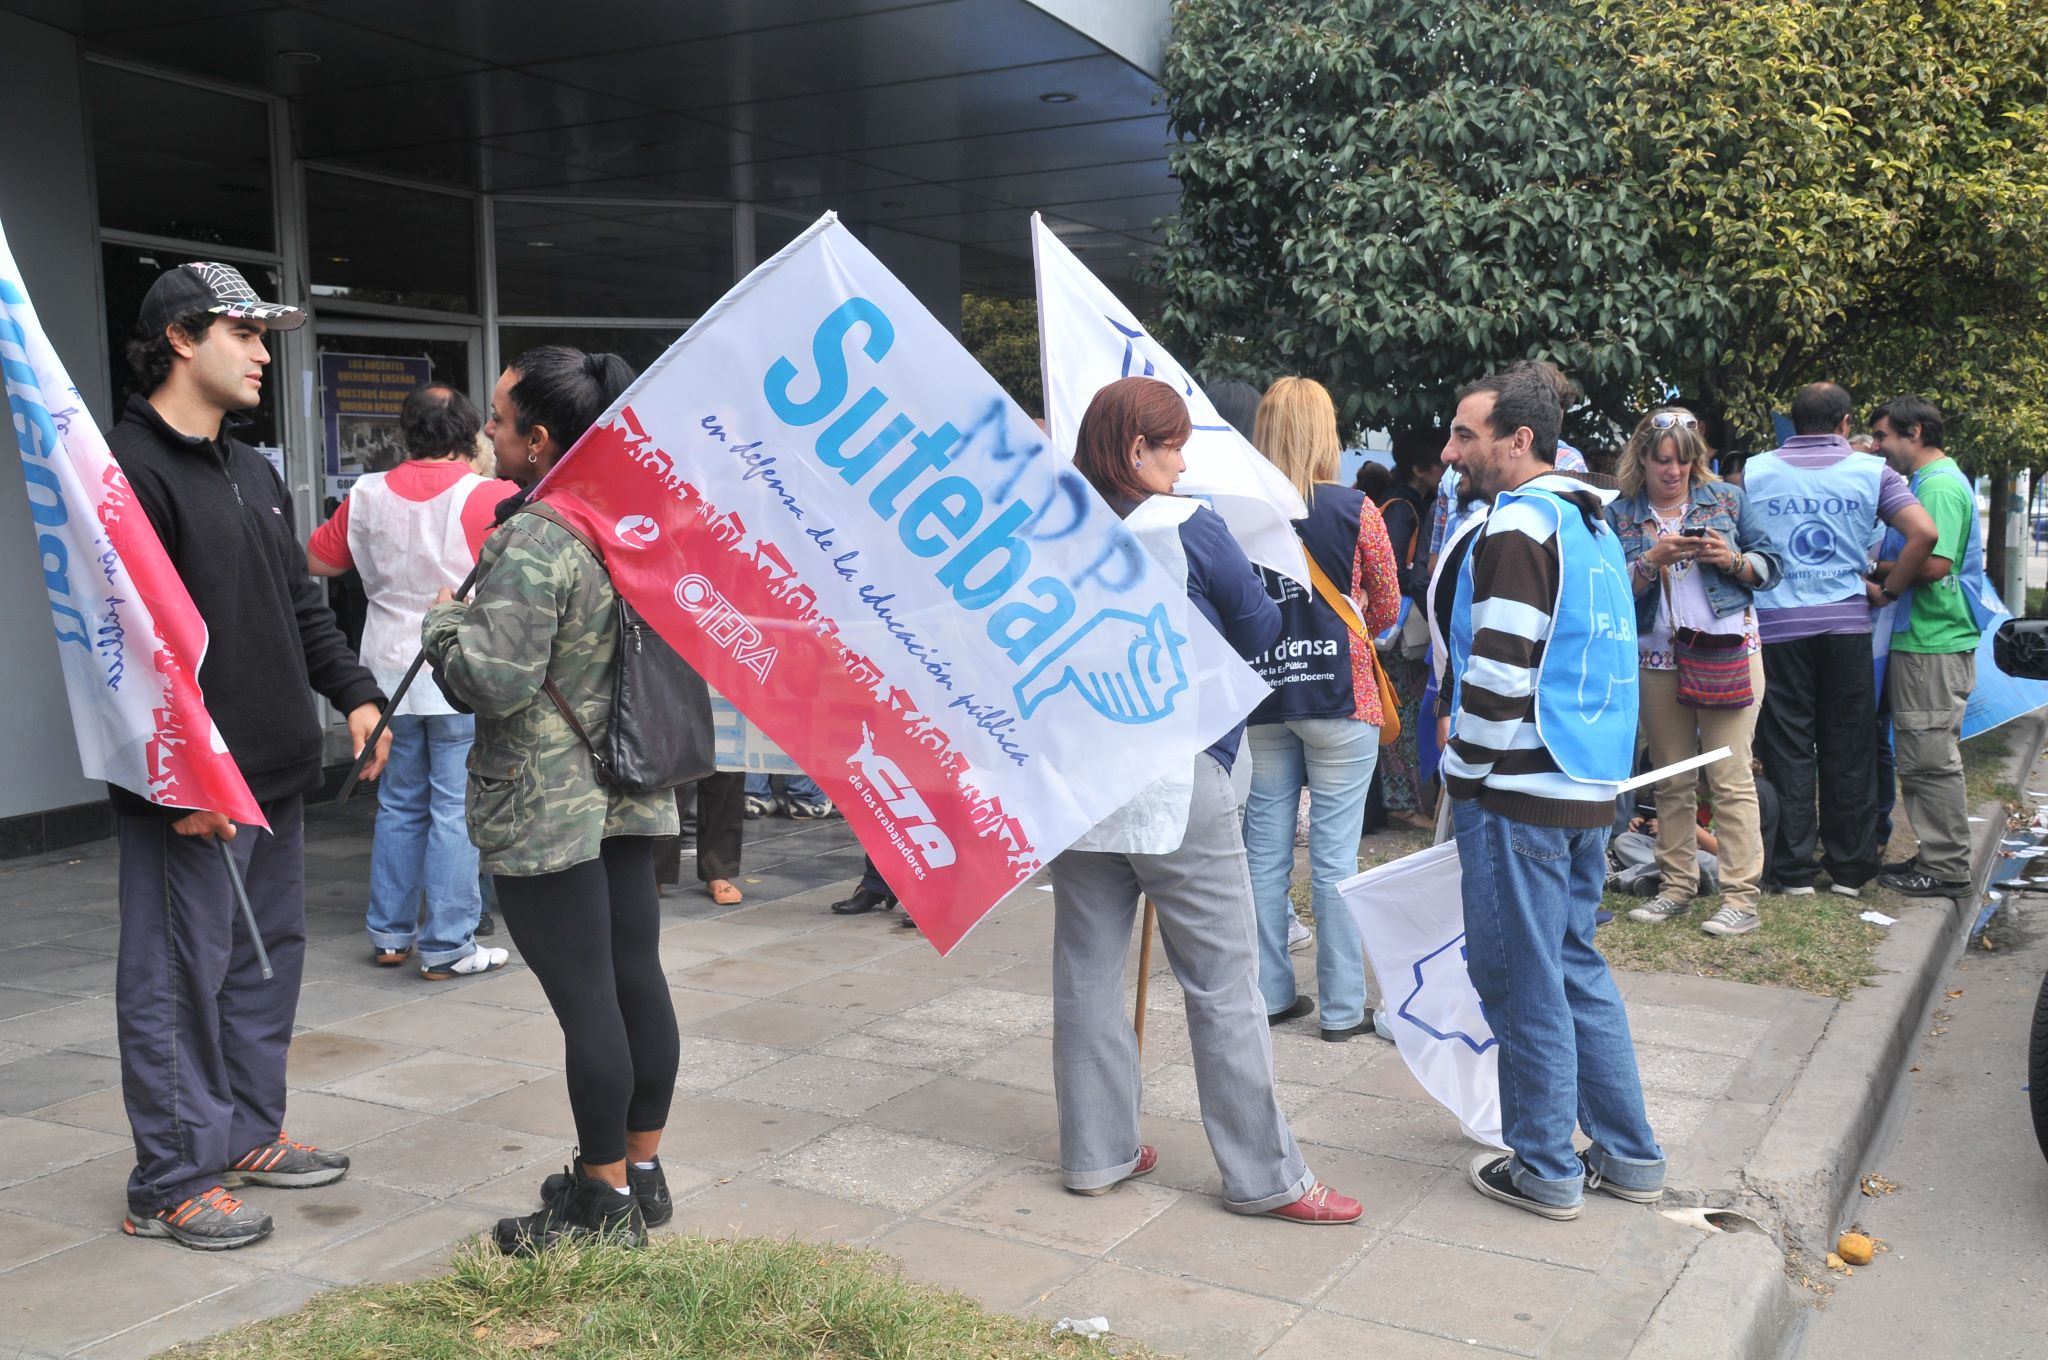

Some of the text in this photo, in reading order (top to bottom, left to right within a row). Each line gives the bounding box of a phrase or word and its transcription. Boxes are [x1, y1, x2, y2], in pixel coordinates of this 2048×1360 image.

[764, 297, 1076, 666] Suteba
[1768, 498, 1860, 516] SADOP
[674, 574, 778, 685] CTERA
[701, 415, 1029, 767] en defensa de la educación pública
[1300, 672, 1335, 682] Docente
[848, 773, 927, 881] de los trabajadores
[862, 754, 956, 869] CTA
